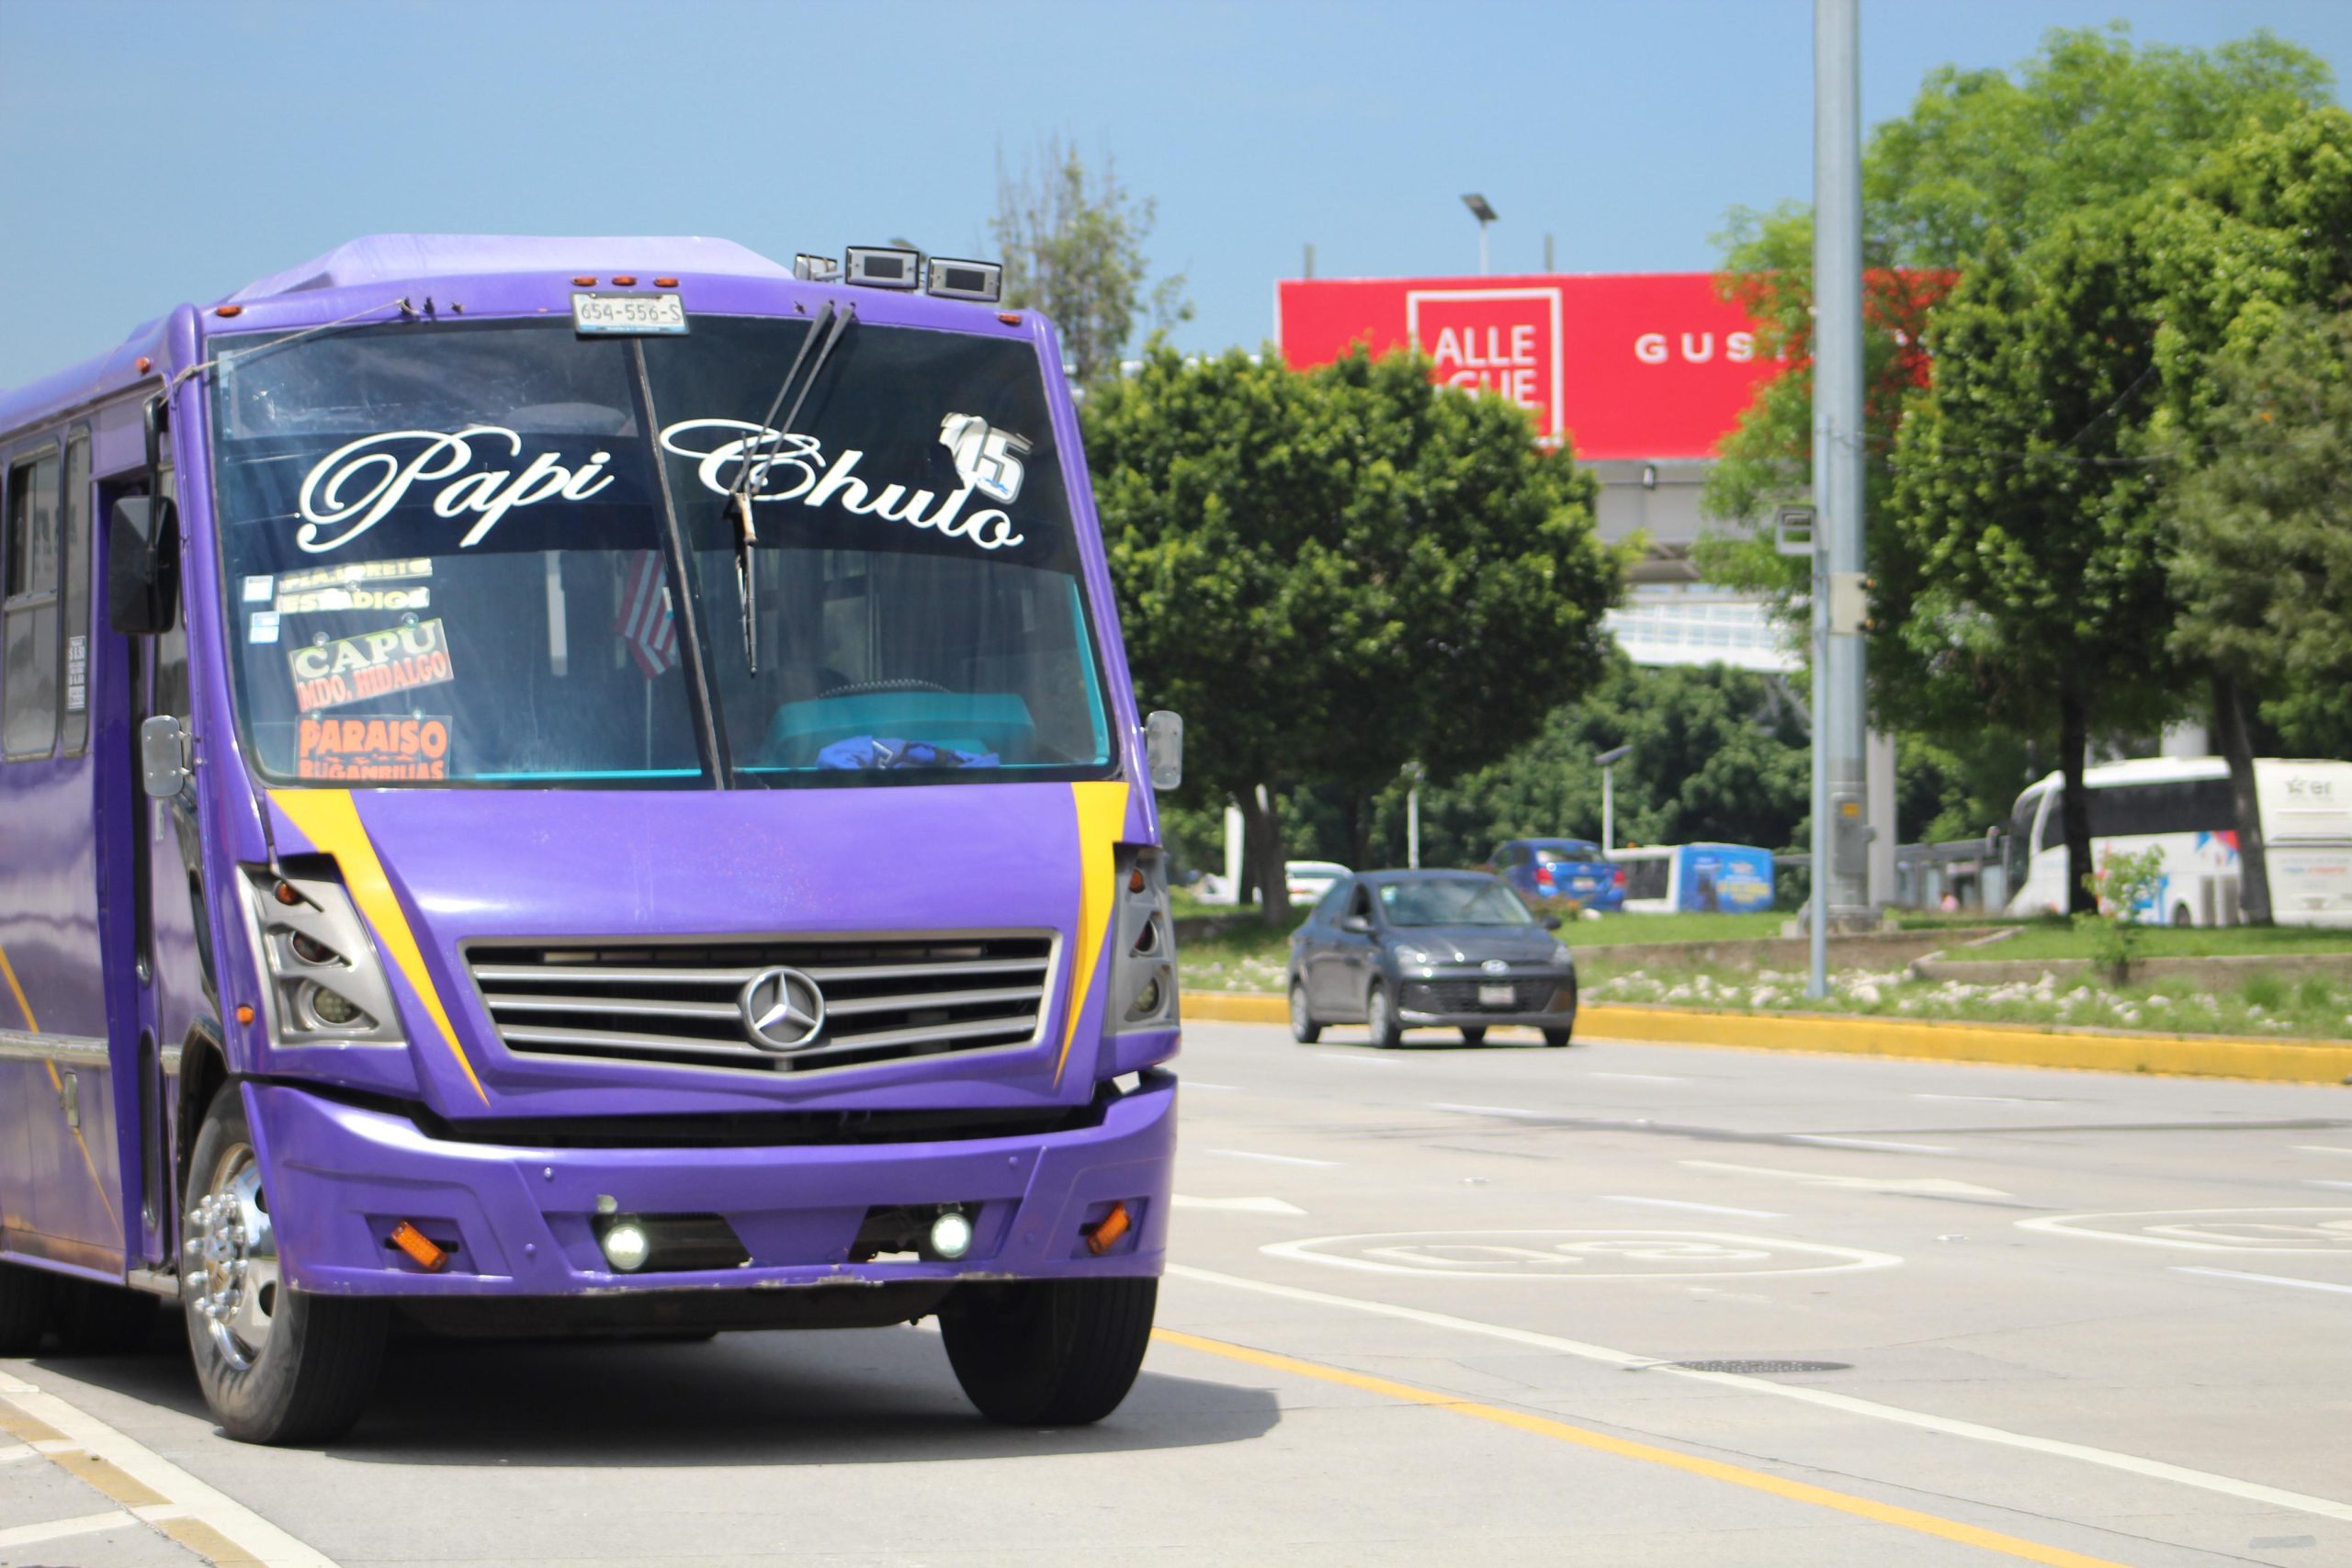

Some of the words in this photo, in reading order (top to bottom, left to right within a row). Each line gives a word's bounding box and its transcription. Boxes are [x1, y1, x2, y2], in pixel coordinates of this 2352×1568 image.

[1433, 323, 1537, 368] ALLE
[1634, 331, 1788, 365] GUS
[296, 426, 616, 554] Papi
[659, 418, 1025, 550] Chulo
[294, 620, 438, 679] CAPU
[299, 674, 354, 713] MDO.
[353, 652, 447, 700] HIDALGO
[300, 719, 448, 759] PARAISO
